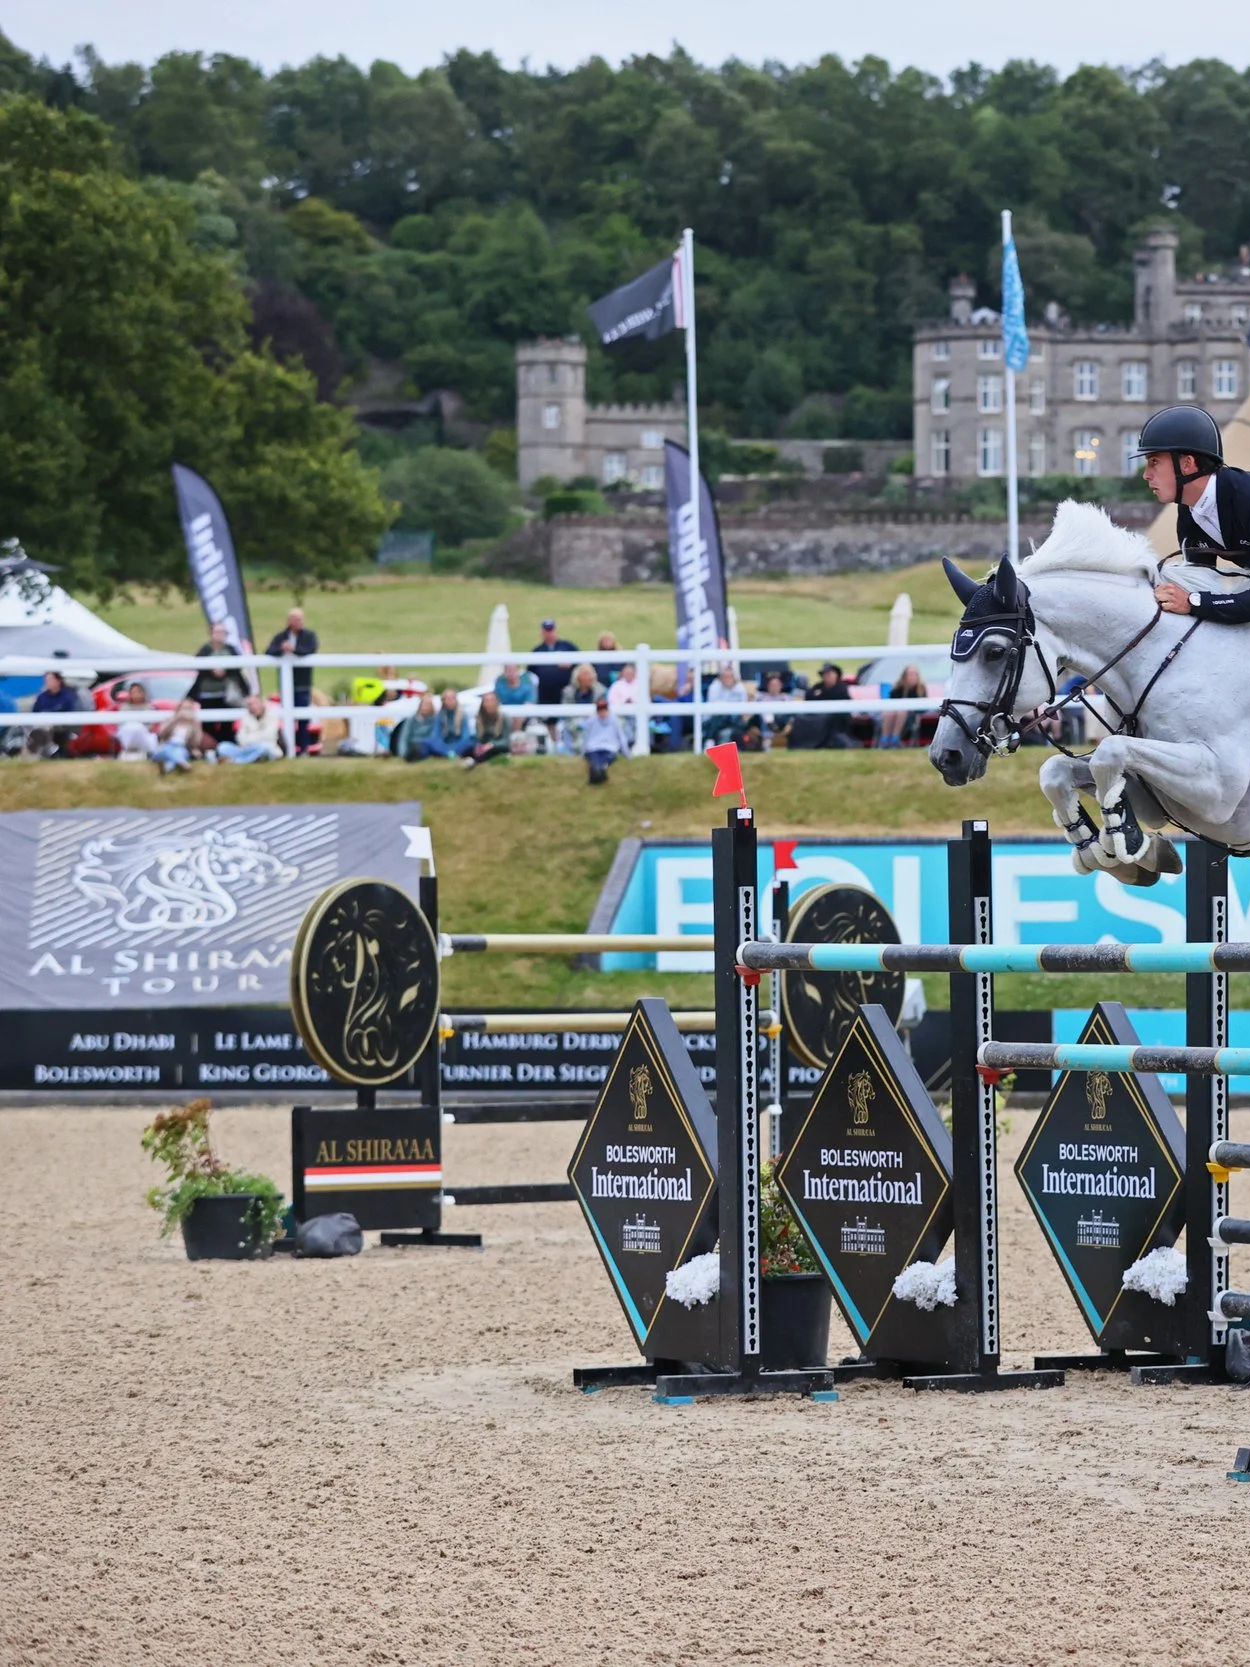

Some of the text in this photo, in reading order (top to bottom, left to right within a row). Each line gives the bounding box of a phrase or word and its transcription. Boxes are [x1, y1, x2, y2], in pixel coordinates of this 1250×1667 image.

[28, 951, 94, 976] AL
[101, 973, 263, 997] TOUR
[68, 1032, 176, 1051] ABU DHABI
[214, 1031, 238, 1051] LE
[240, 1031, 292, 1051] LAME
[461, 1032, 622, 1050] HAMBURG DERBY
[34, 1064, 160, 1083] BOLESWORTH
[199, 1063, 250, 1082] KING
[515, 1063, 556, 1082] DER
[315, 1138, 435, 1163] AL SHIRA'AA
[606, 1145, 676, 1165] BOLESWORTH
[820, 1148, 903, 1169] BOLESWORTH
[1059, 1143, 1138, 1164] BOLESWORTH
[591, 1166, 692, 1202] International
[803, 1169, 923, 1205] International
[1042, 1163, 1156, 1199] International
